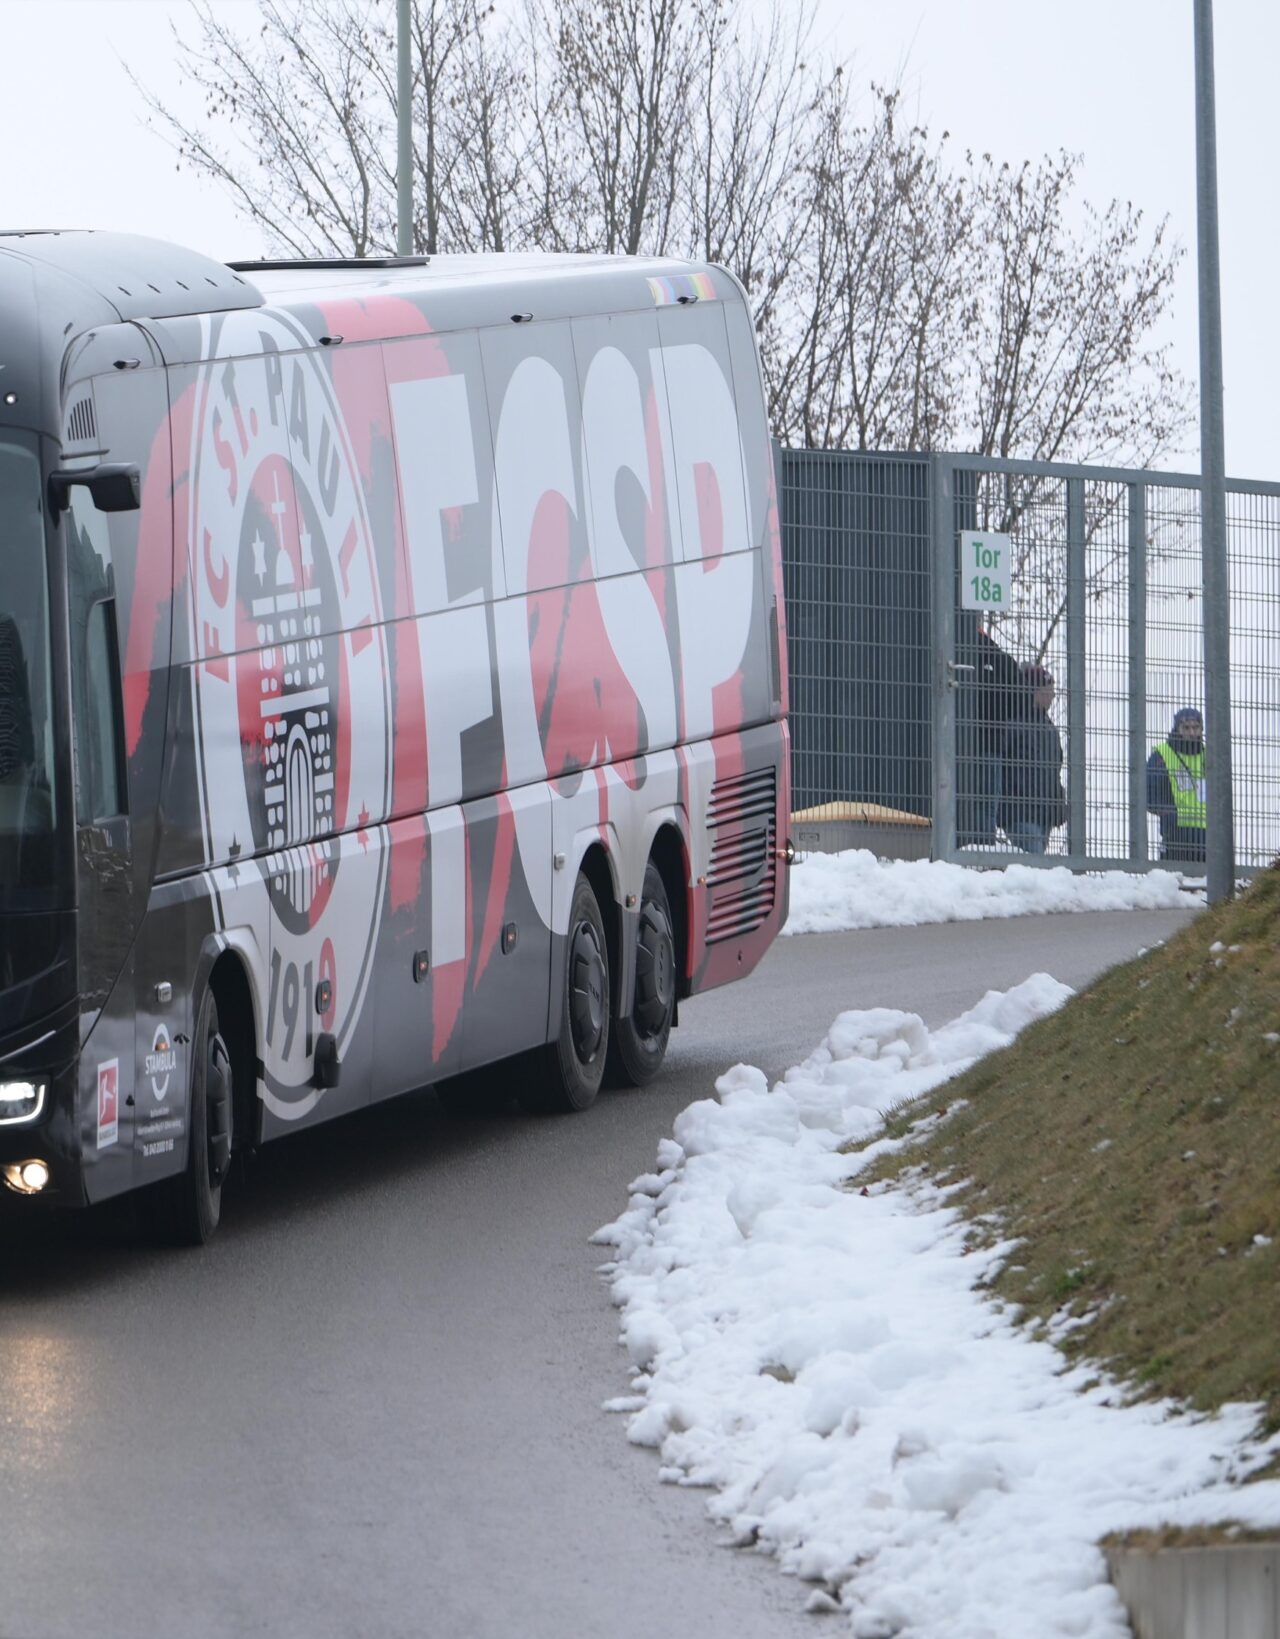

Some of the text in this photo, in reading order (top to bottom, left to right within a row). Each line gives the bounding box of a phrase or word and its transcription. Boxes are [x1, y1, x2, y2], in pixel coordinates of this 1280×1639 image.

[203, 527, 231, 683] FC
[970, 575, 1002, 602] 18a
[972, 541, 1001, 569] Tor
[389, 343, 755, 967] FCSP
[265, 937, 337, 1062] 1910
